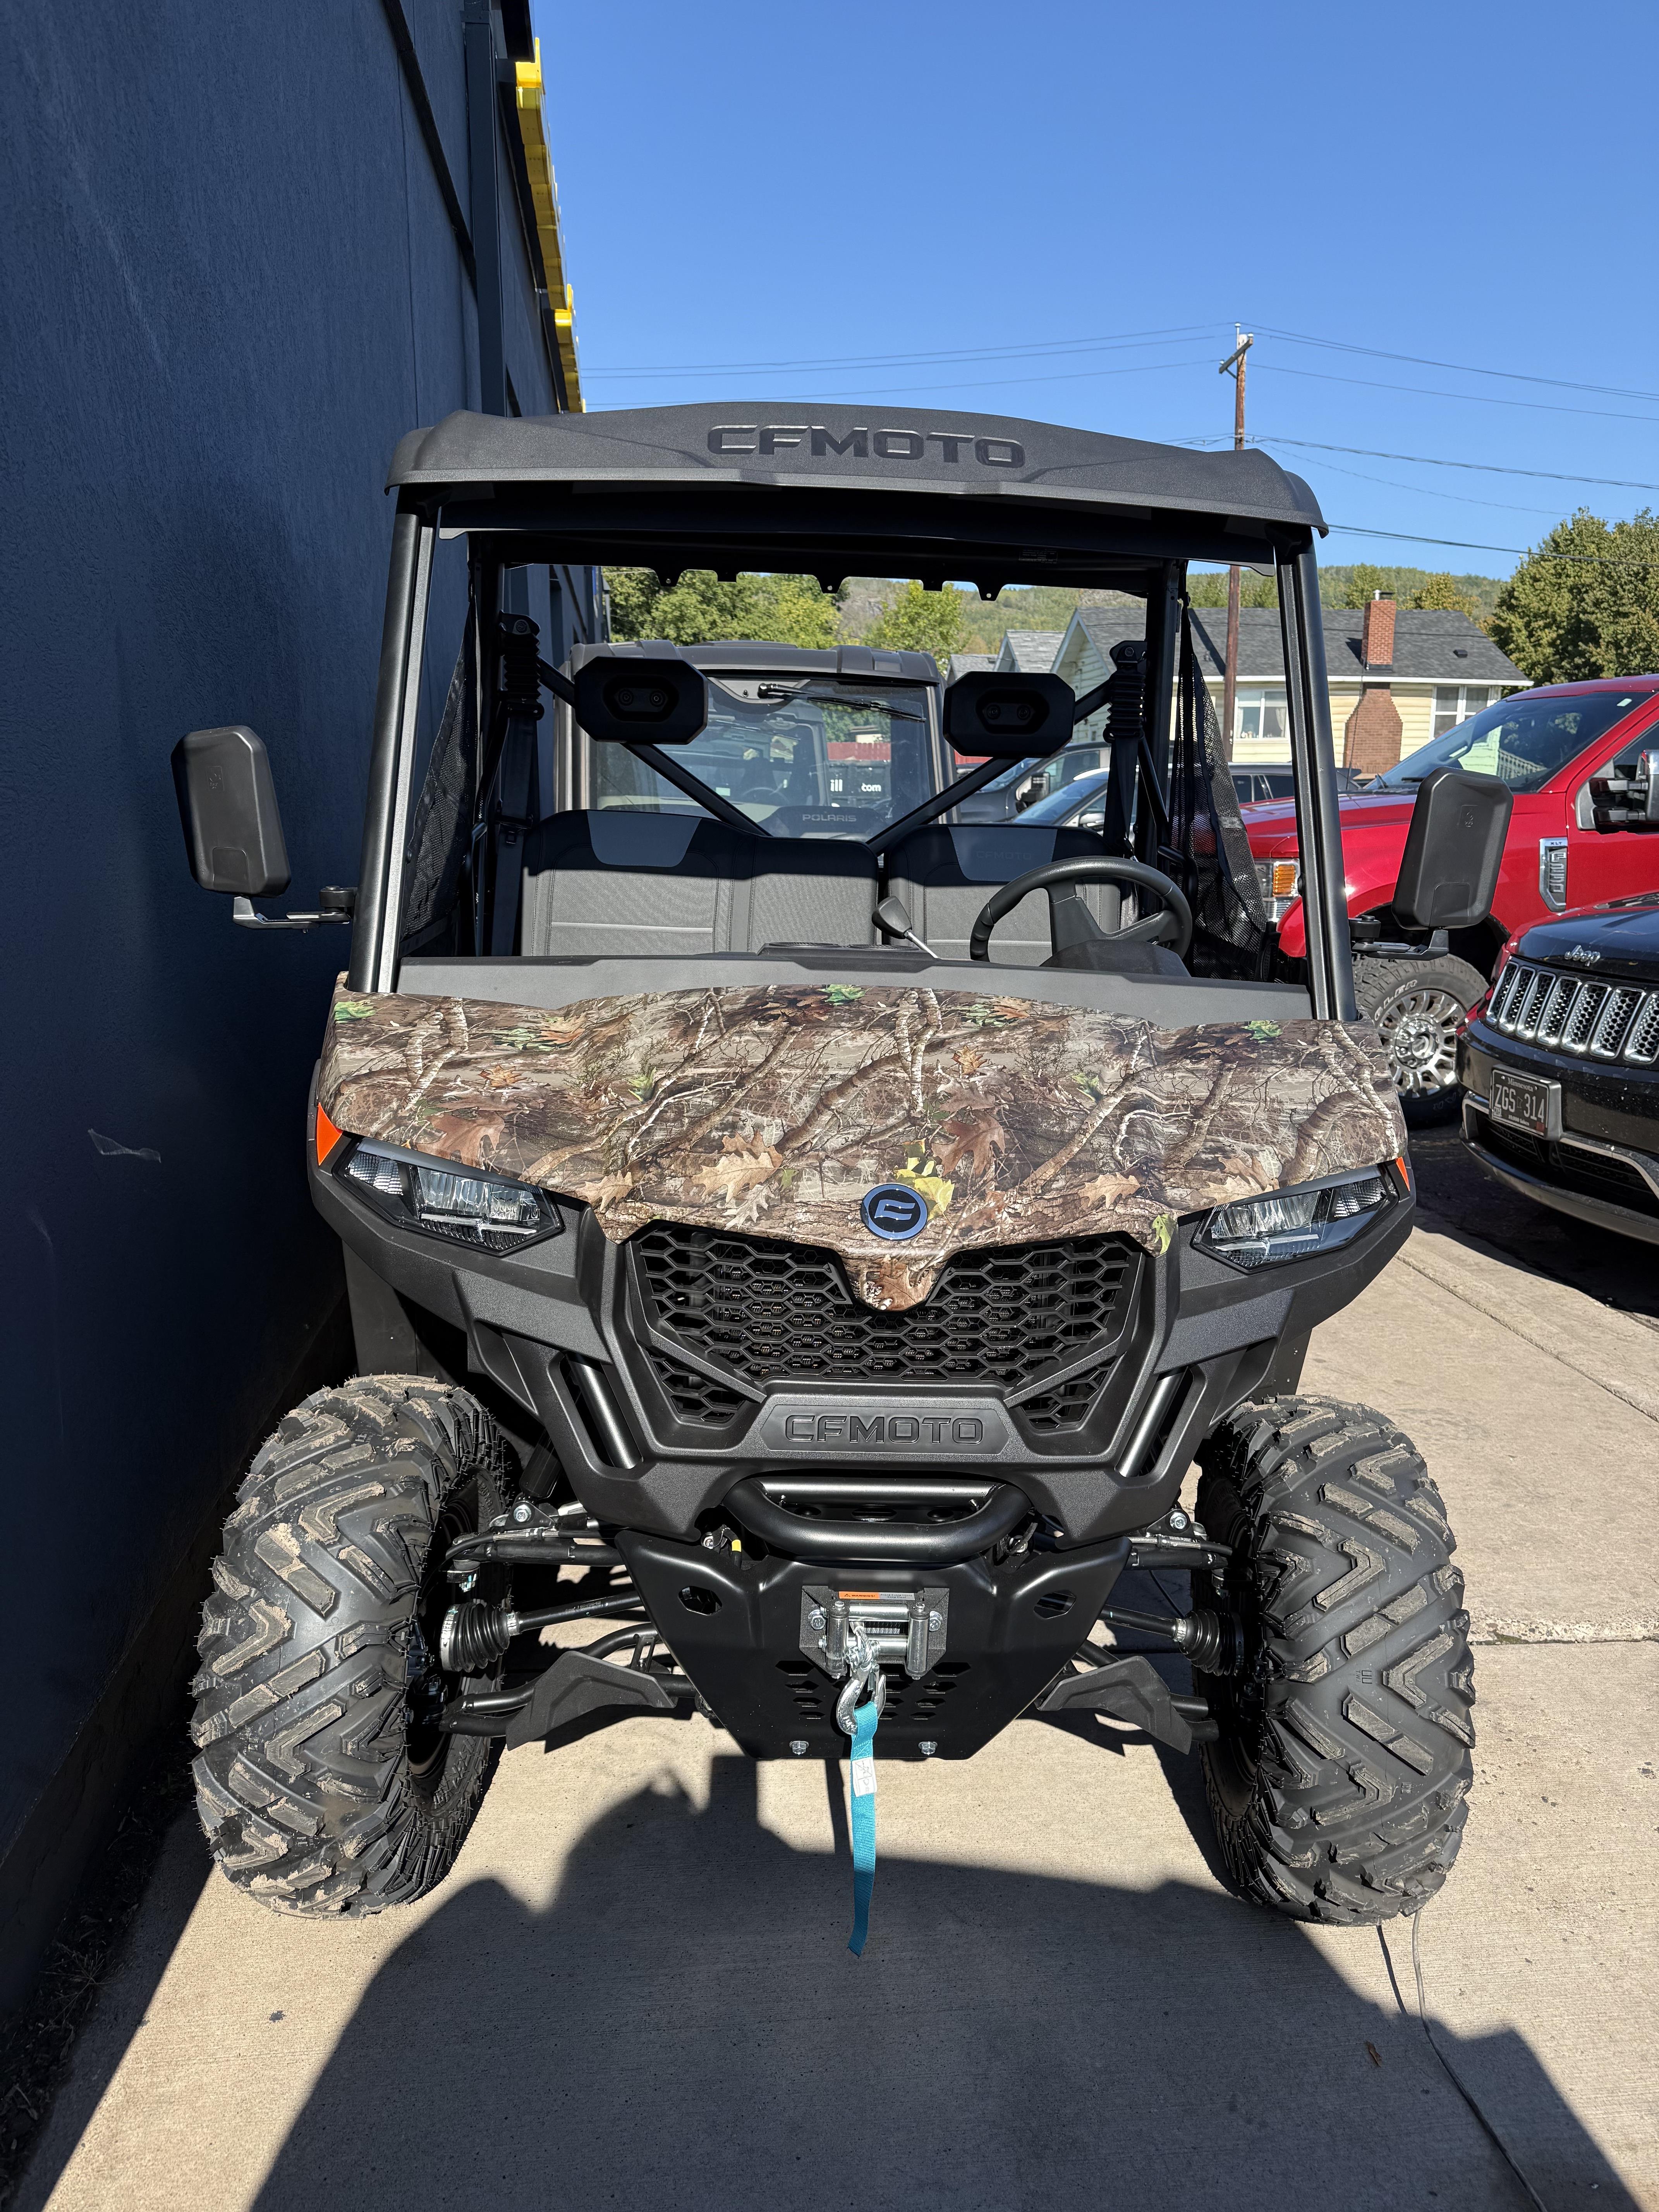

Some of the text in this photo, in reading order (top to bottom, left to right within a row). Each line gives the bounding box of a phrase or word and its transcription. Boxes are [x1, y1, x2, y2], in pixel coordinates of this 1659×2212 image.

[707, 424, 1026, 469] CFMOTO
[802, 814, 857, 822] POLARIS
[1565, 945, 1600, 967] Jeep
[1508, 1077, 1533, 1092] Minnesota
[1495, 1084, 1544, 1123] ZGS 314
[785, 1414, 984, 1444] CFMOTO
